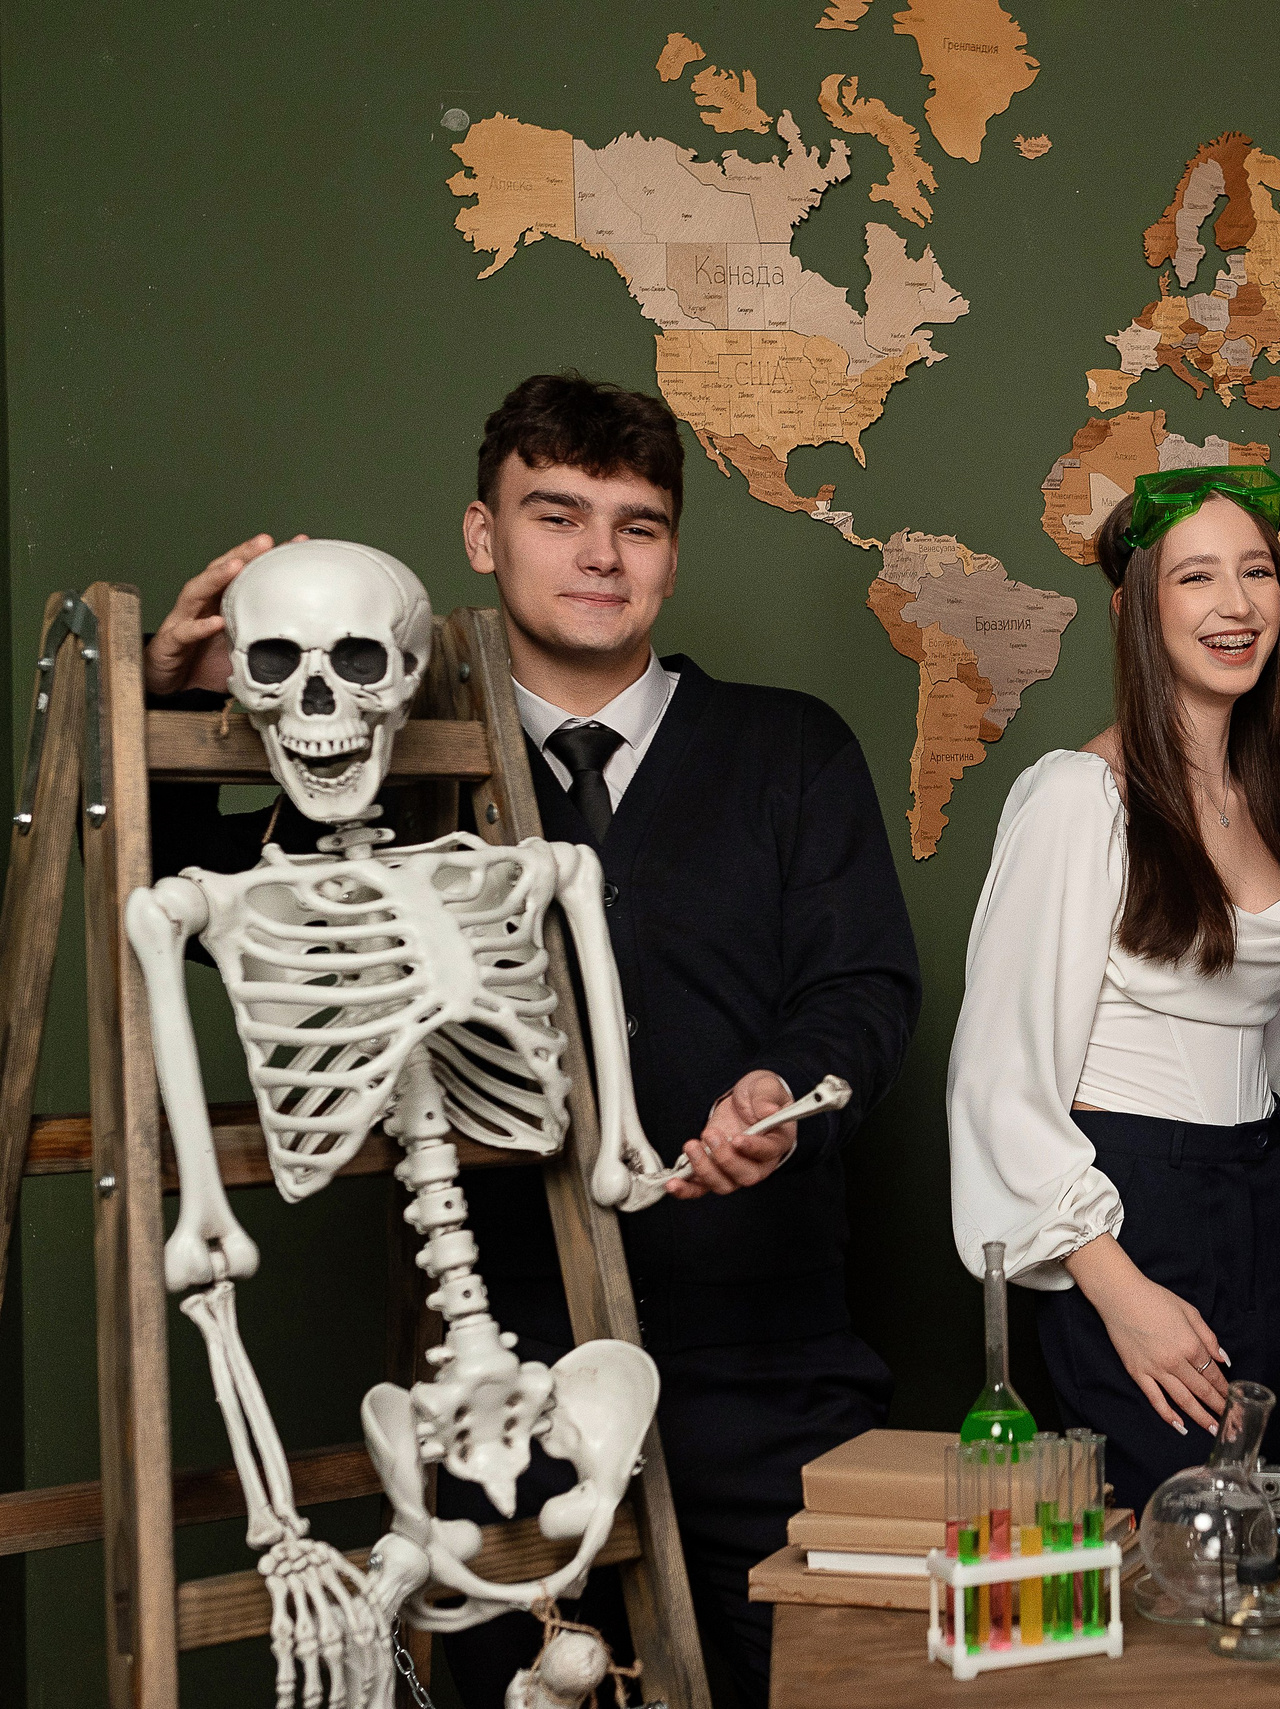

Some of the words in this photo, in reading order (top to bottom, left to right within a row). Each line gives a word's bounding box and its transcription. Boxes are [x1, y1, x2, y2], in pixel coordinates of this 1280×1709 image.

[943, 38, 999, 54] Гренландия
[695, 255, 784, 288] Канада
[735, 360, 789, 386] США
[975, 617, 1032, 634] Бразилия
[930, 752, 975, 763] Аргентина
